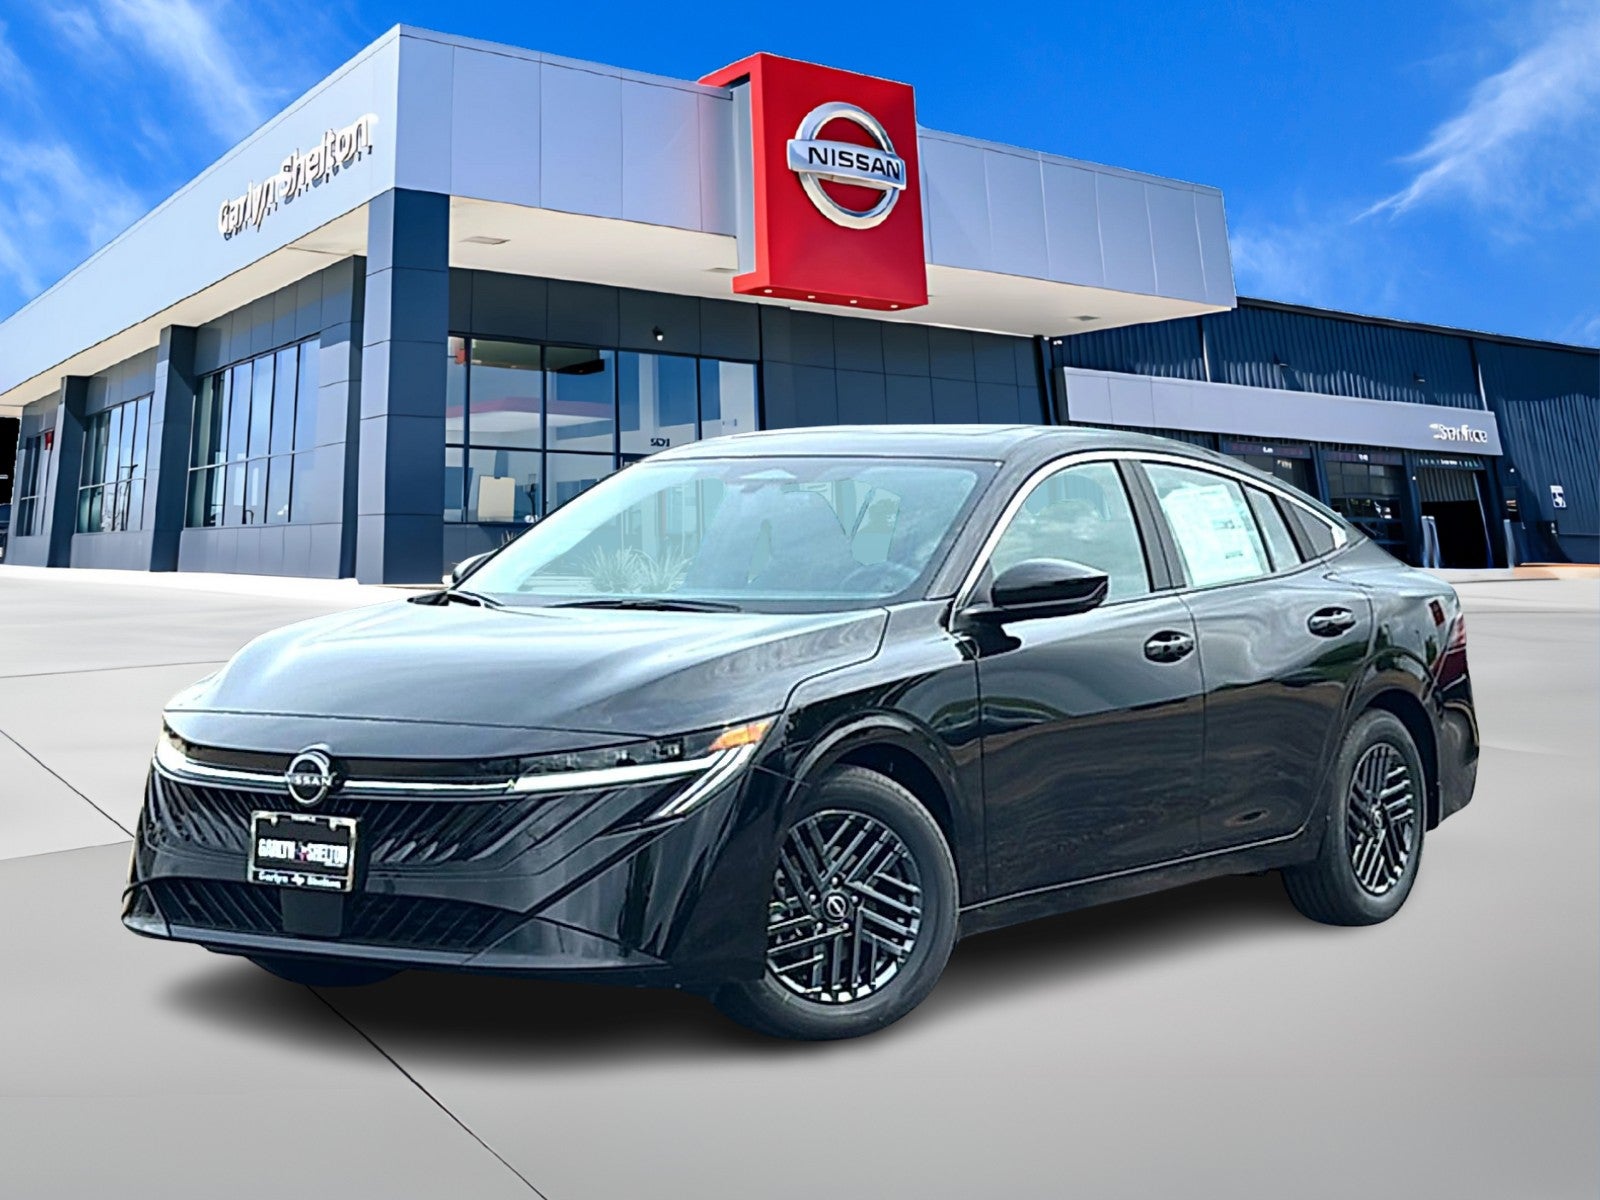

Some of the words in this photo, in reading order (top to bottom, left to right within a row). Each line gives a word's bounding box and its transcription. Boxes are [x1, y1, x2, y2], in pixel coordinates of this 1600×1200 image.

[279, 113, 377, 203] Shelton
[808, 146, 900, 181] NISSAN
[1429, 423, 1488, 443] Service
[287, 773, 332, 786] SSAN
